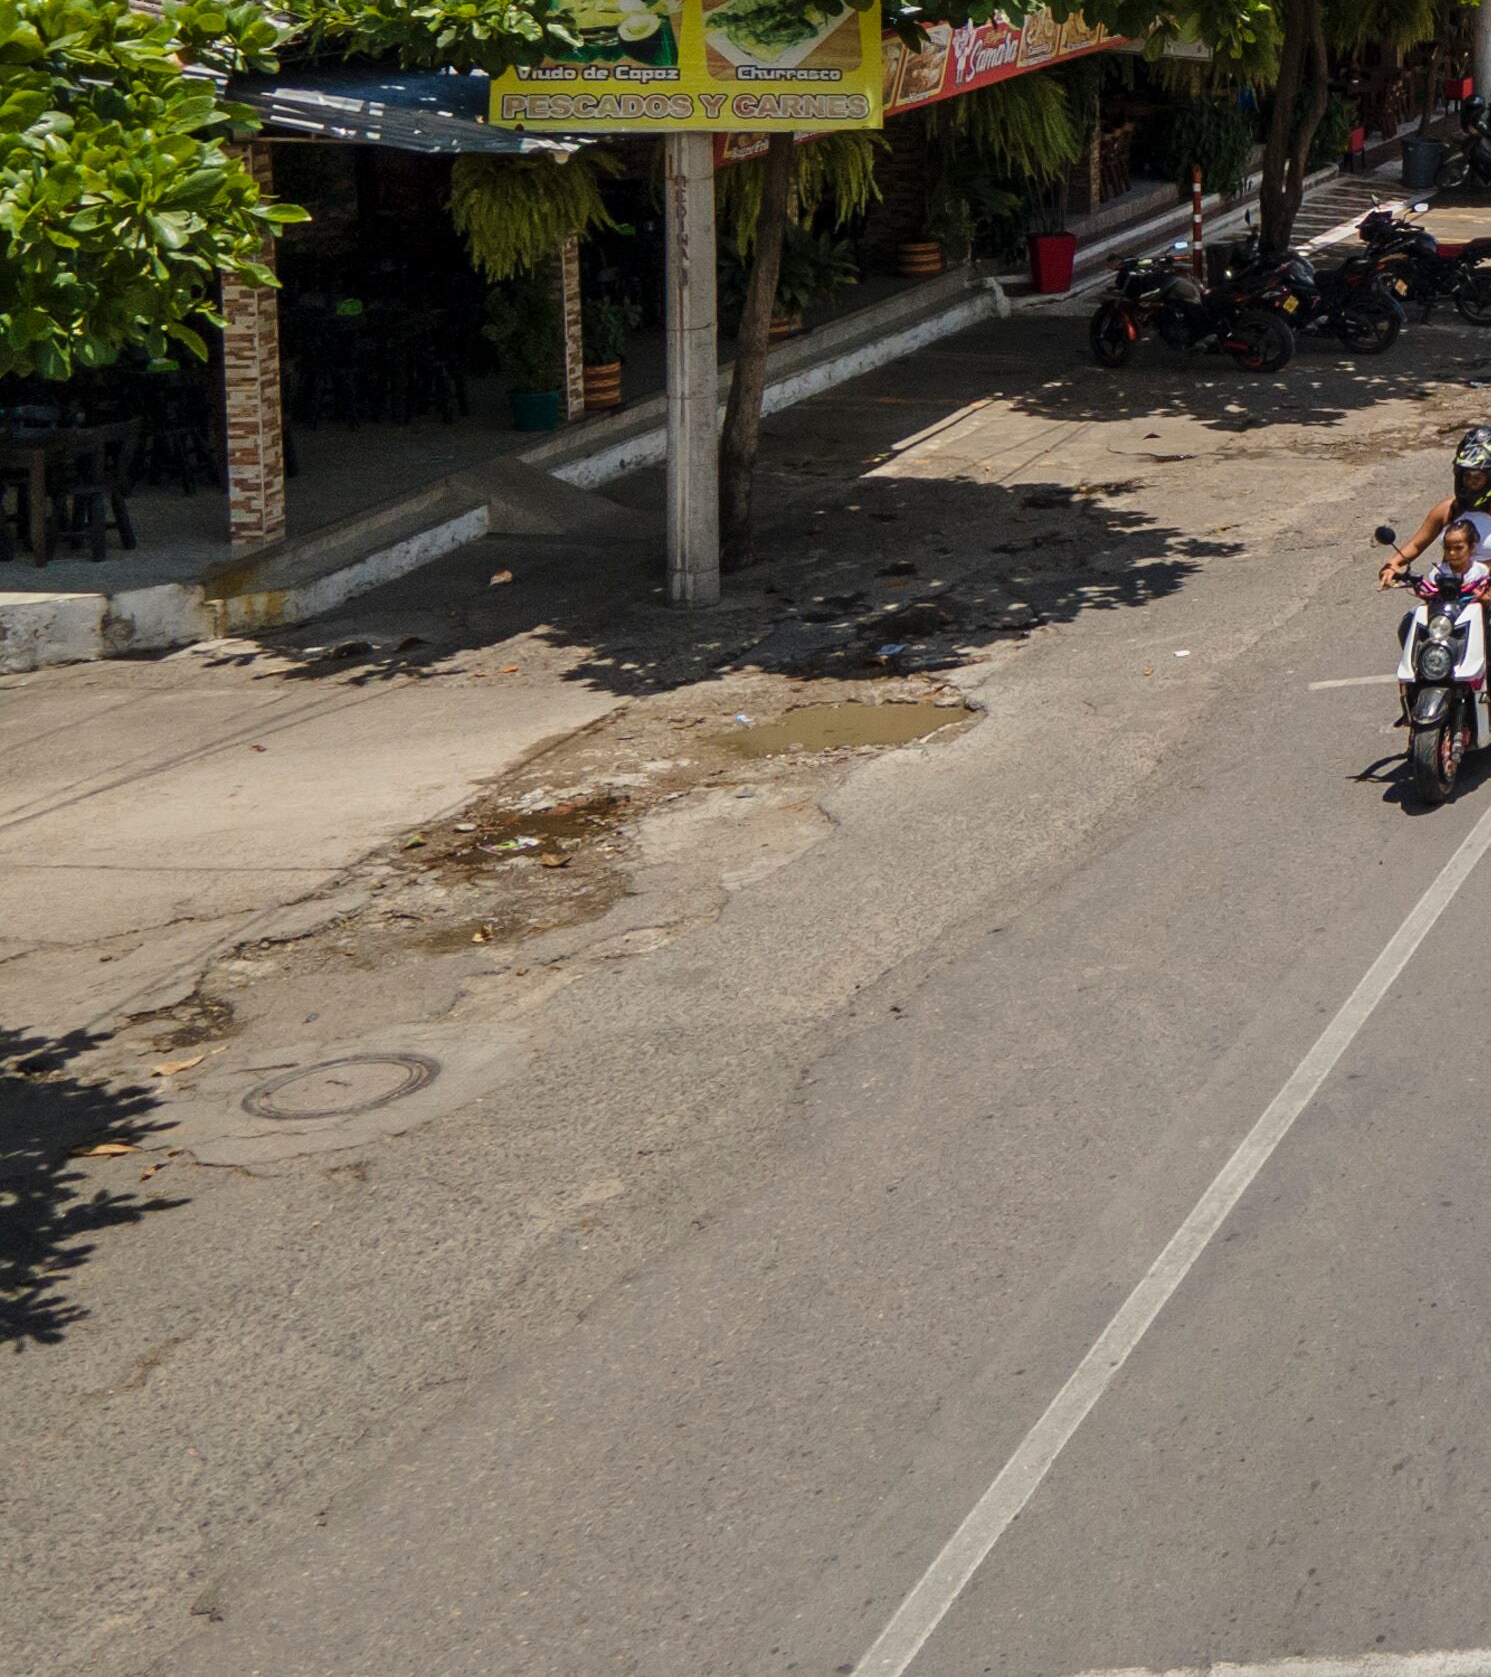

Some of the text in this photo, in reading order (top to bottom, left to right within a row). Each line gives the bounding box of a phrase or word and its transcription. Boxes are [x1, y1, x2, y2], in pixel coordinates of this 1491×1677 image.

[583, 65, 608, 80] de
[614, 65, 680, 84] Capaz
[737, 65, 842, 81] Churrasco
[502, 93, 870, 120] PESCADOS Y CARNES
